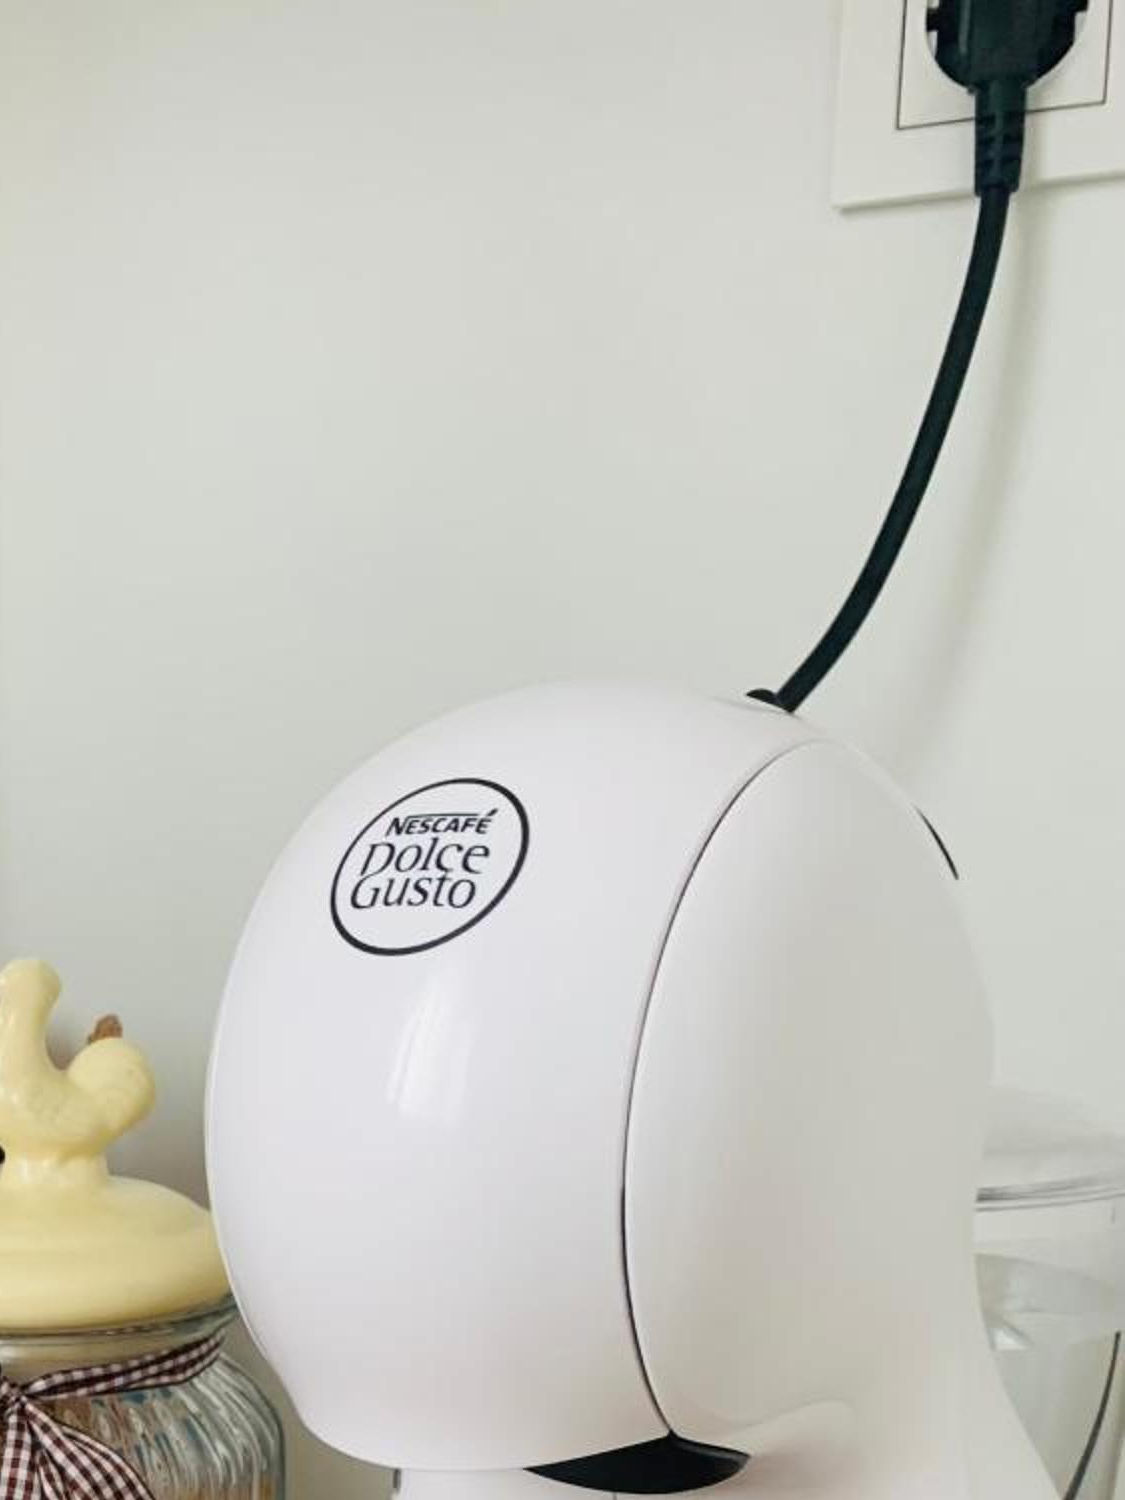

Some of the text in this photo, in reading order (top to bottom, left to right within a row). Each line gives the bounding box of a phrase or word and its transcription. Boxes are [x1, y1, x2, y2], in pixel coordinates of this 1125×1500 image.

[385, 808, 498, 837] NESCAFÉ
[360, 838, 490, 876] Dolce
[350, 872, 477, 910] Gusto
